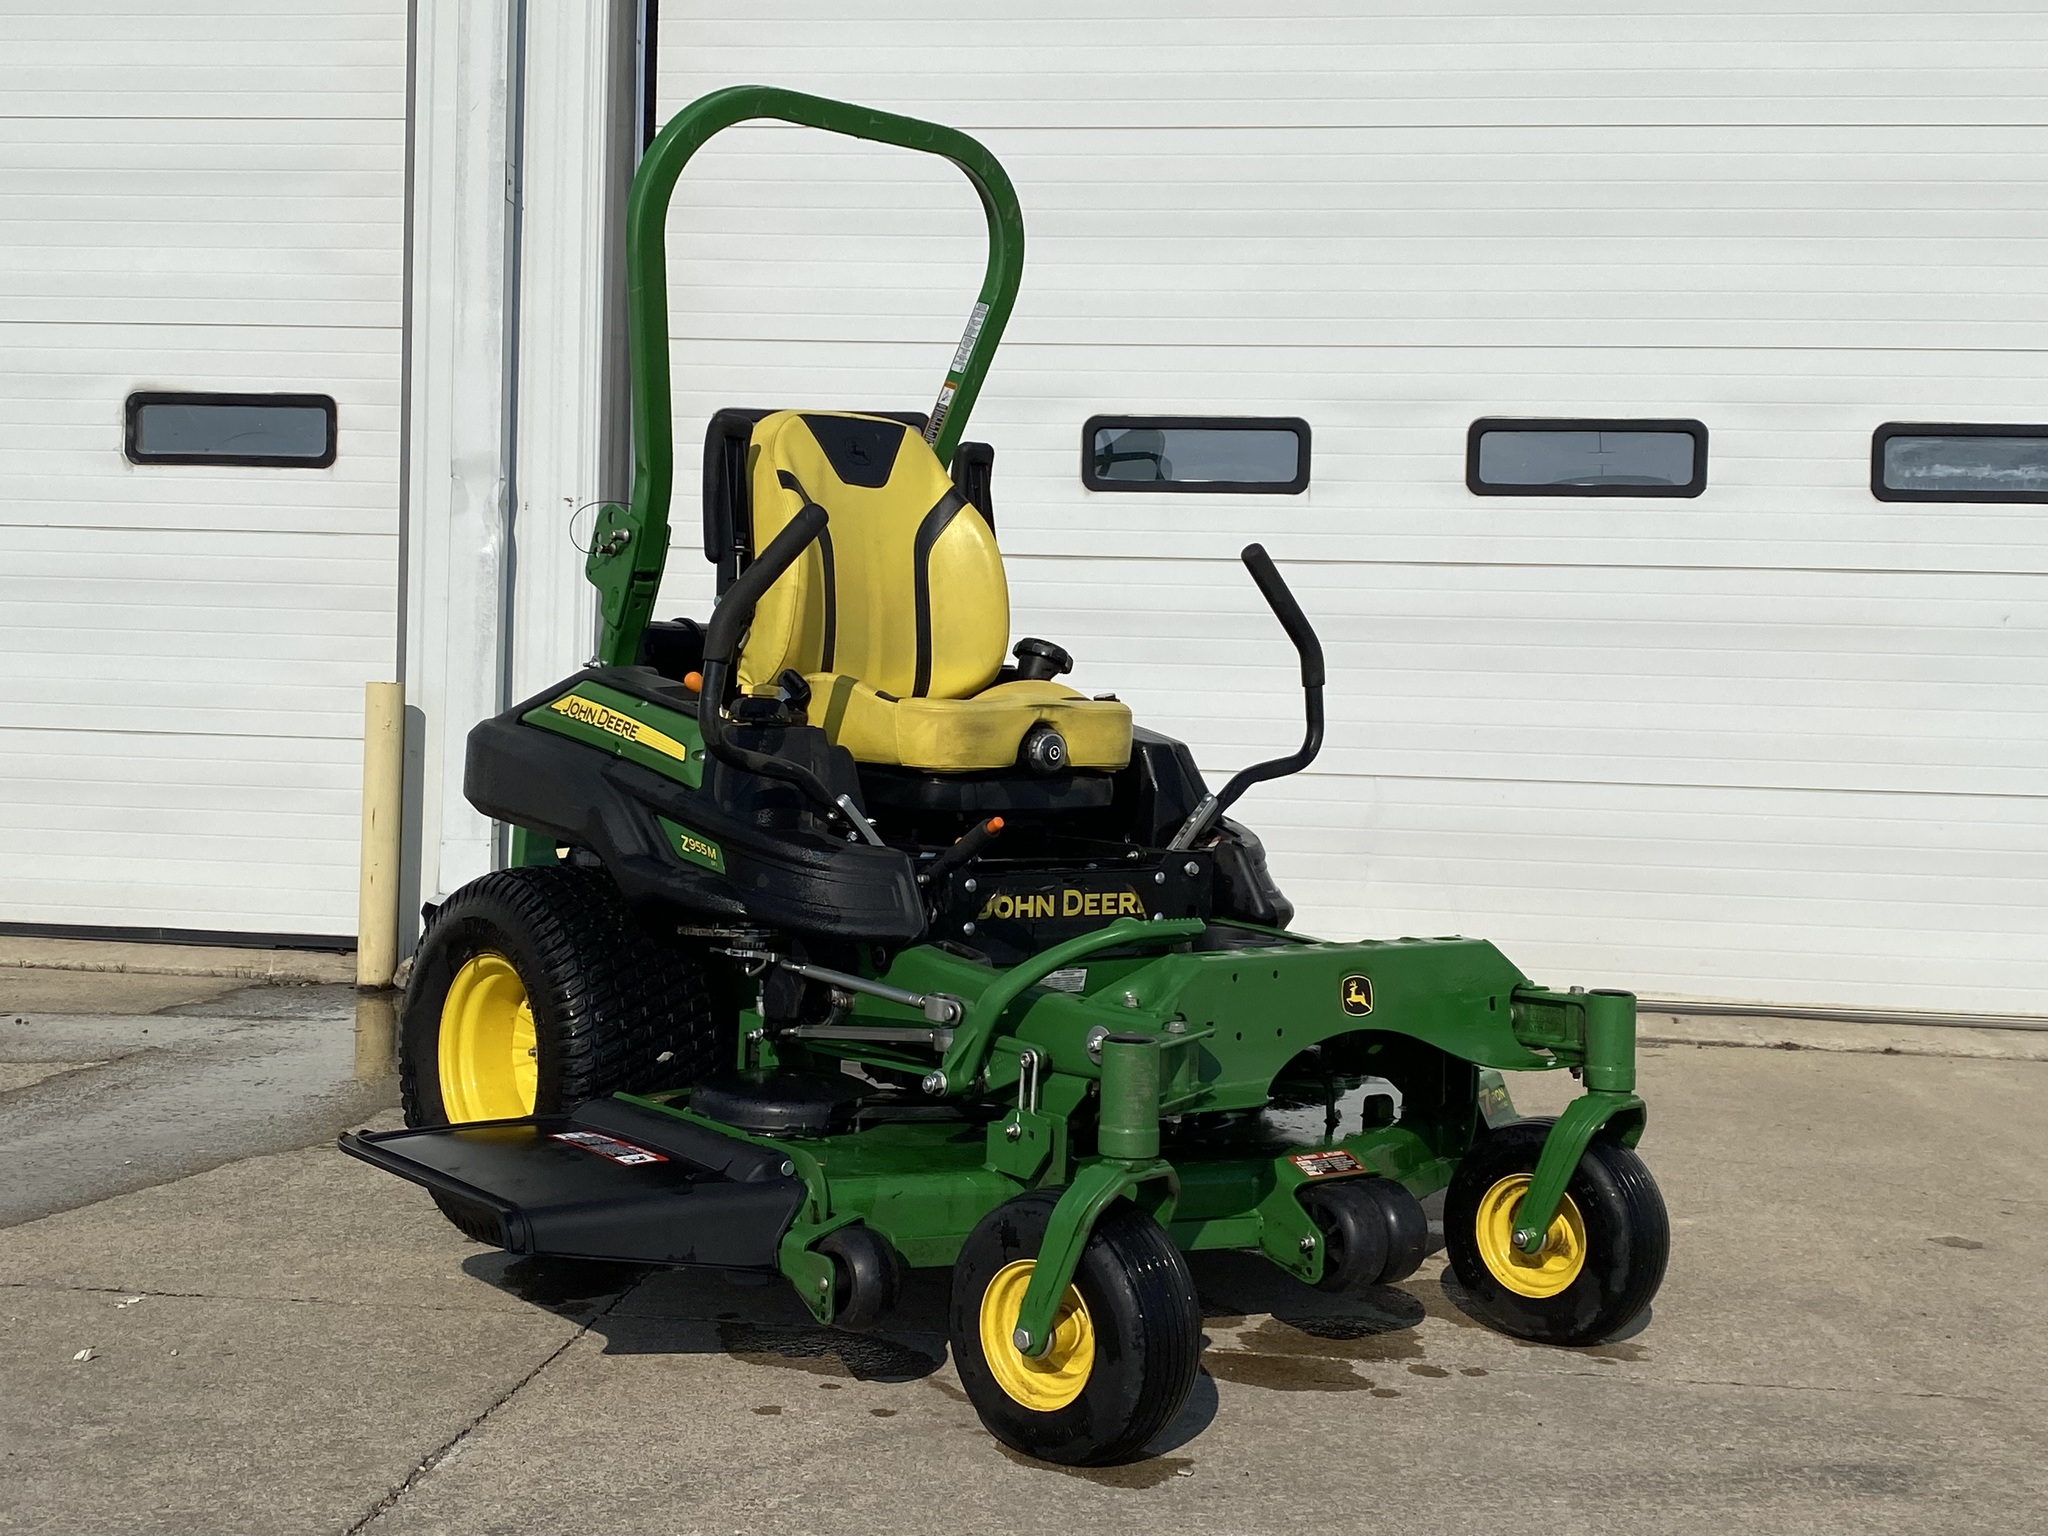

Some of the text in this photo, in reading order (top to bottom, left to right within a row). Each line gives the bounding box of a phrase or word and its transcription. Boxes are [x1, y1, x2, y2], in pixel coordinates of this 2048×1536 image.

[562, 697, 640, 740] JOHN DEERE
[680, 834, 717, 860] Z955M
